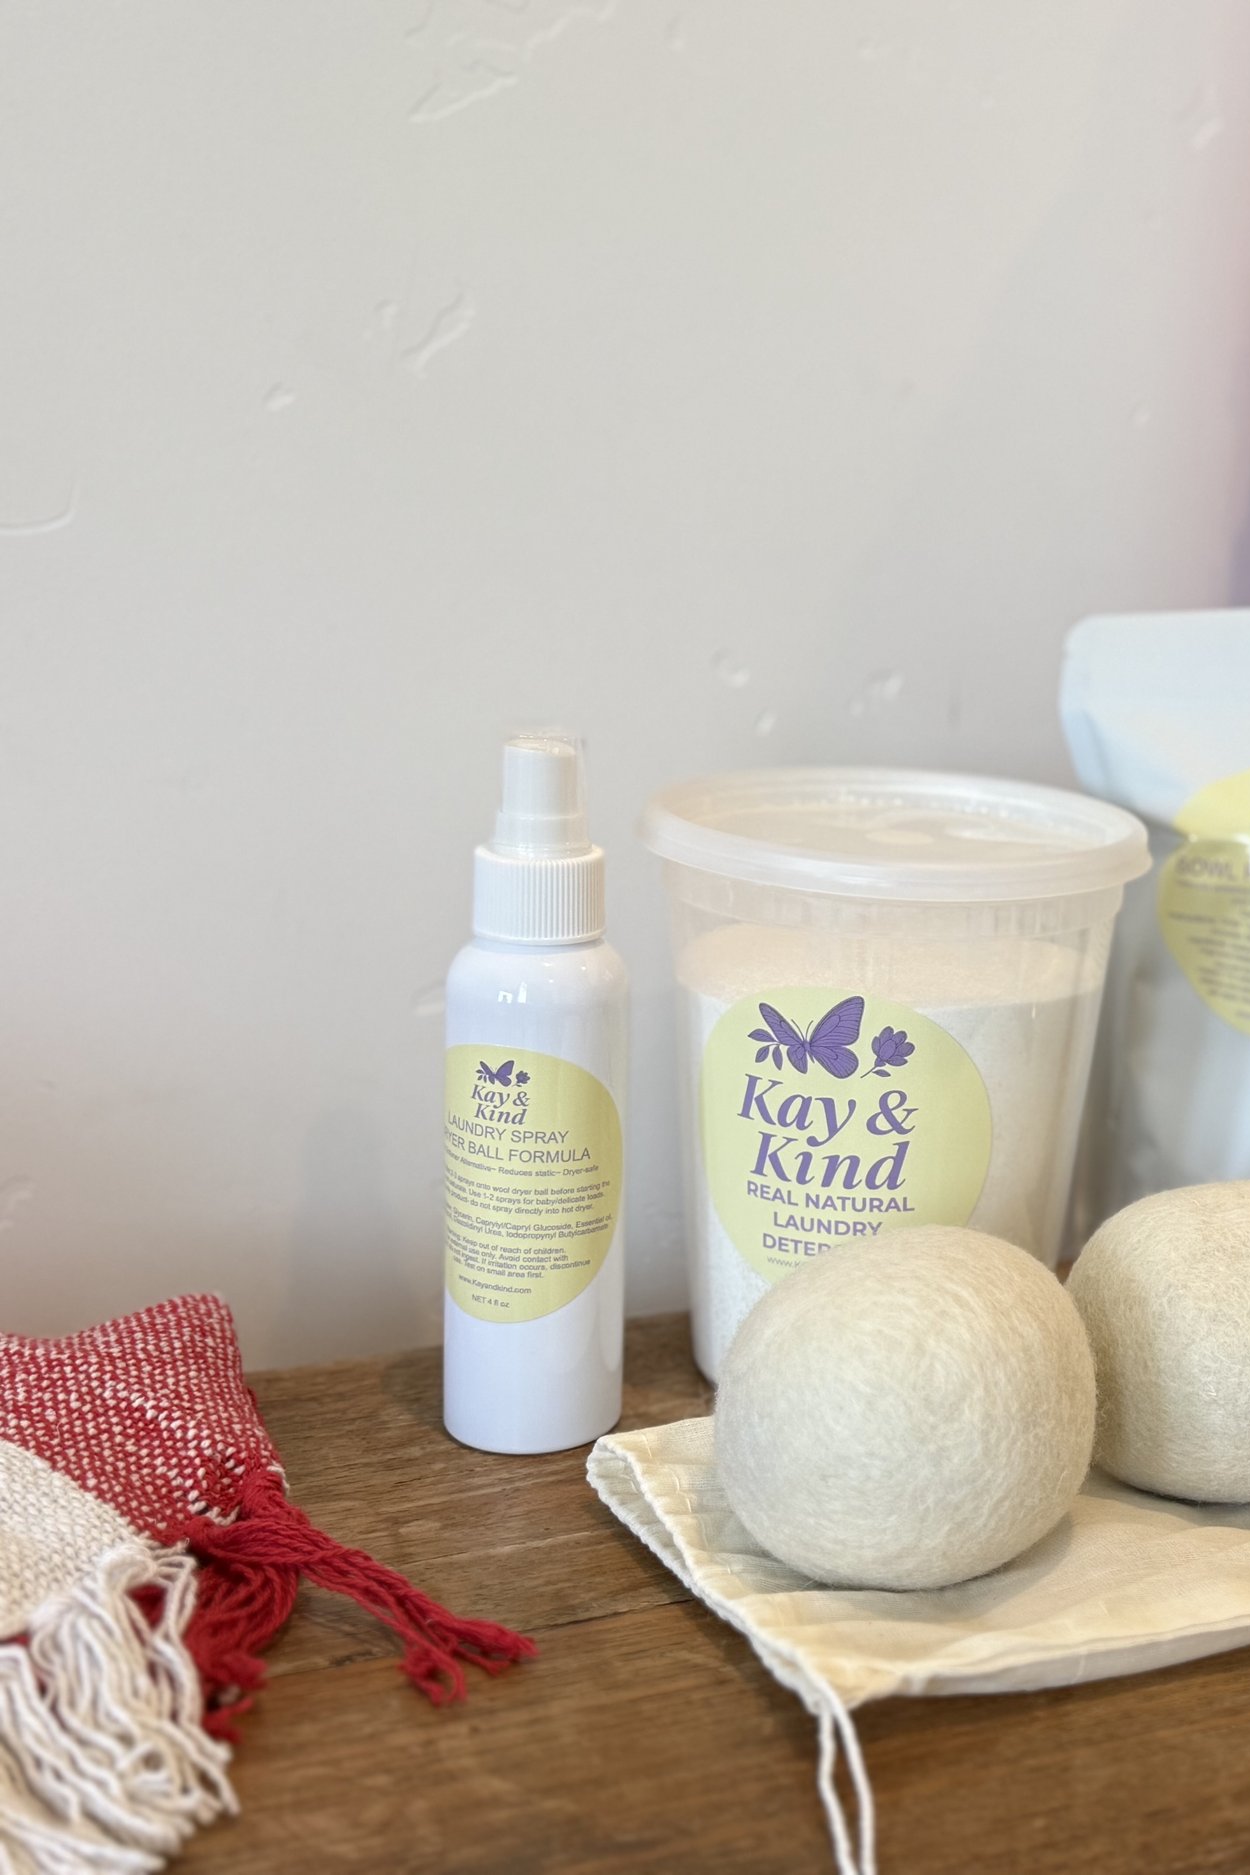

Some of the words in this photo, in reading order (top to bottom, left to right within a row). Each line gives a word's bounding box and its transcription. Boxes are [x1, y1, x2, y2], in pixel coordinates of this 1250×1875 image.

[470, 1083, 511, 1109] Kay
[512, 1090, 531, 1108] &
[473, 1102, 528, 1126] Kind
[737, 1073, 857, 1147] Kay
[866, 1090, 920, 1136] &
[447, 1109, 508, 1141] LAUNDRY
[511, 1129, 570, 1145] SPRAY
[468, 1140, 505, 1161] BALL
[508, 1146, 592, 1164] FORMULA
[750, 1131, 911, 1190] Kind
[491, 1186, 511, 1194] wool
[511, 1187, 533, 1197] dryer
[534, 1188, 550, 1196] ball
[550, 1187, 575, 1195] before
[522, 1196, 535, 1205] for
[747, 1179, 800, 1207] REAL
[804, 1192, 917, 1213] NATURAL
[491, 1204, 514, 1215] spray
[545, 1206, 561, 1215] into
[561, 1204, 575, 1214] hot
[773, 1211, 884, 1237] LAUNDRY
[500, 1246, 522, 1255] reach
[522, 1247, 532, 1255] of
[762, 1233, 846, 1258] DETER
[521, 1254, 552, 1263] contact
[506, 1270, 527, 1278] area
